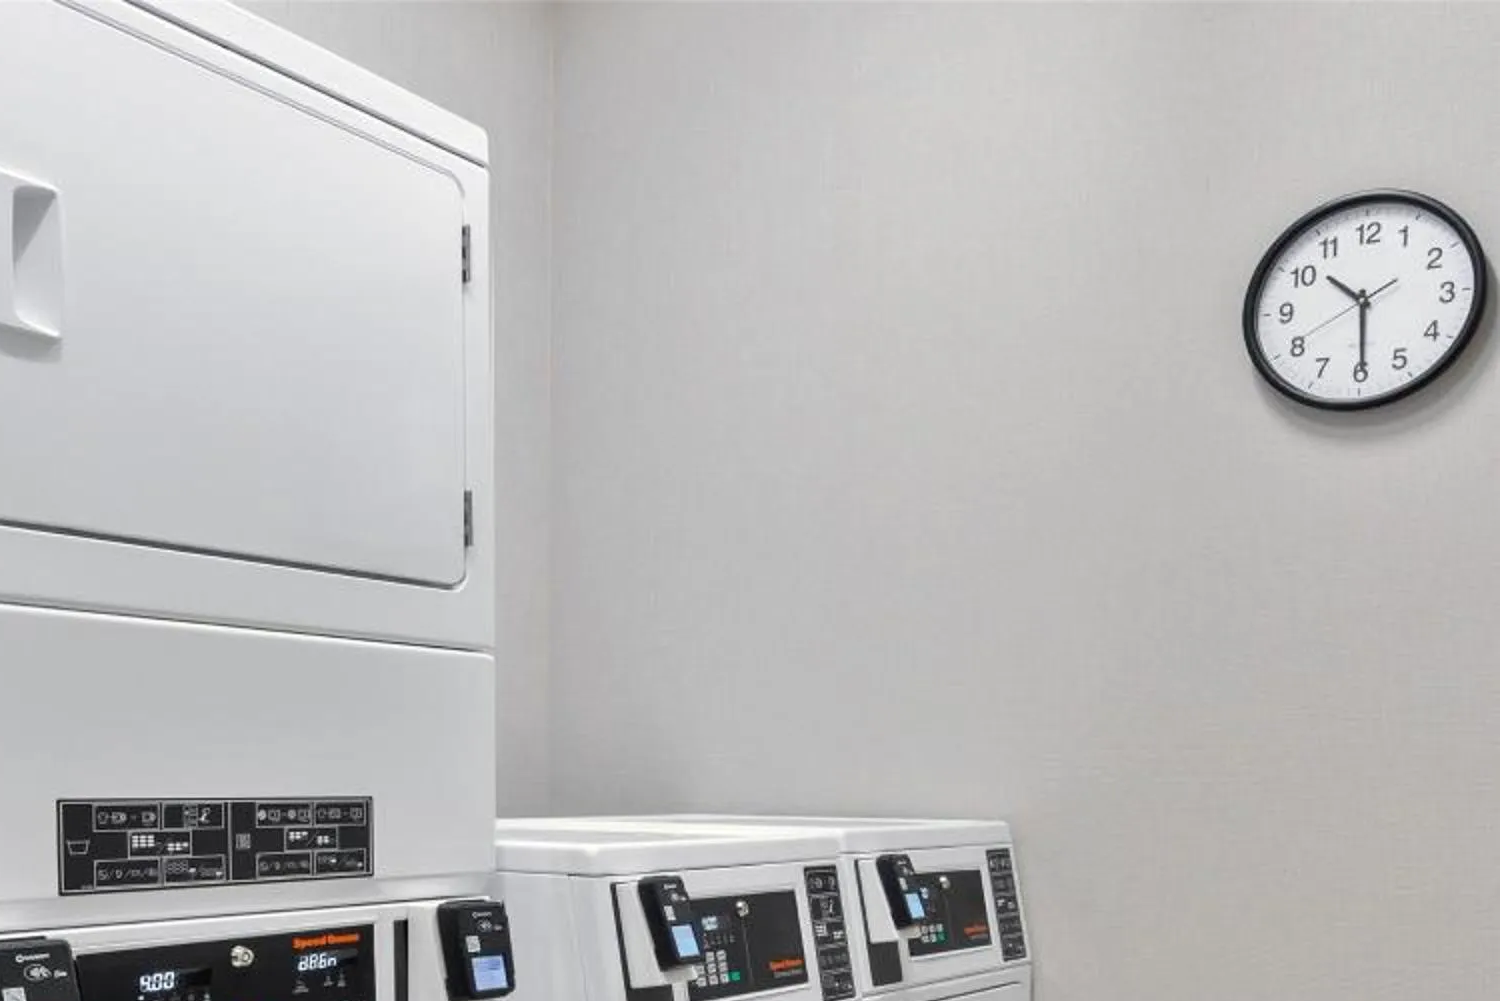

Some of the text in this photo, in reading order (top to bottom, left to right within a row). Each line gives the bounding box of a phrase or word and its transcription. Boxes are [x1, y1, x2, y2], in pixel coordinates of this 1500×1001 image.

[1355, 221, 1382, 245] 12
[1398, 226, 1409, 248] 1
[1319, 237, 1338, 260] 11
[1426, 247, 1443, 270] 2
[1290, 265, 1316, 288] 10
[1439, 281, 1455, 304] 3
[1278, 302, 1294, 324] 9
[1423, 319, 1440, 341] 4
[1290, 336, 1305, 357] 8
[1315, 357, 1330, 379] 7
[1391, 348, 1408, 370] 5
[1353, 361, 1368, 383] 6
